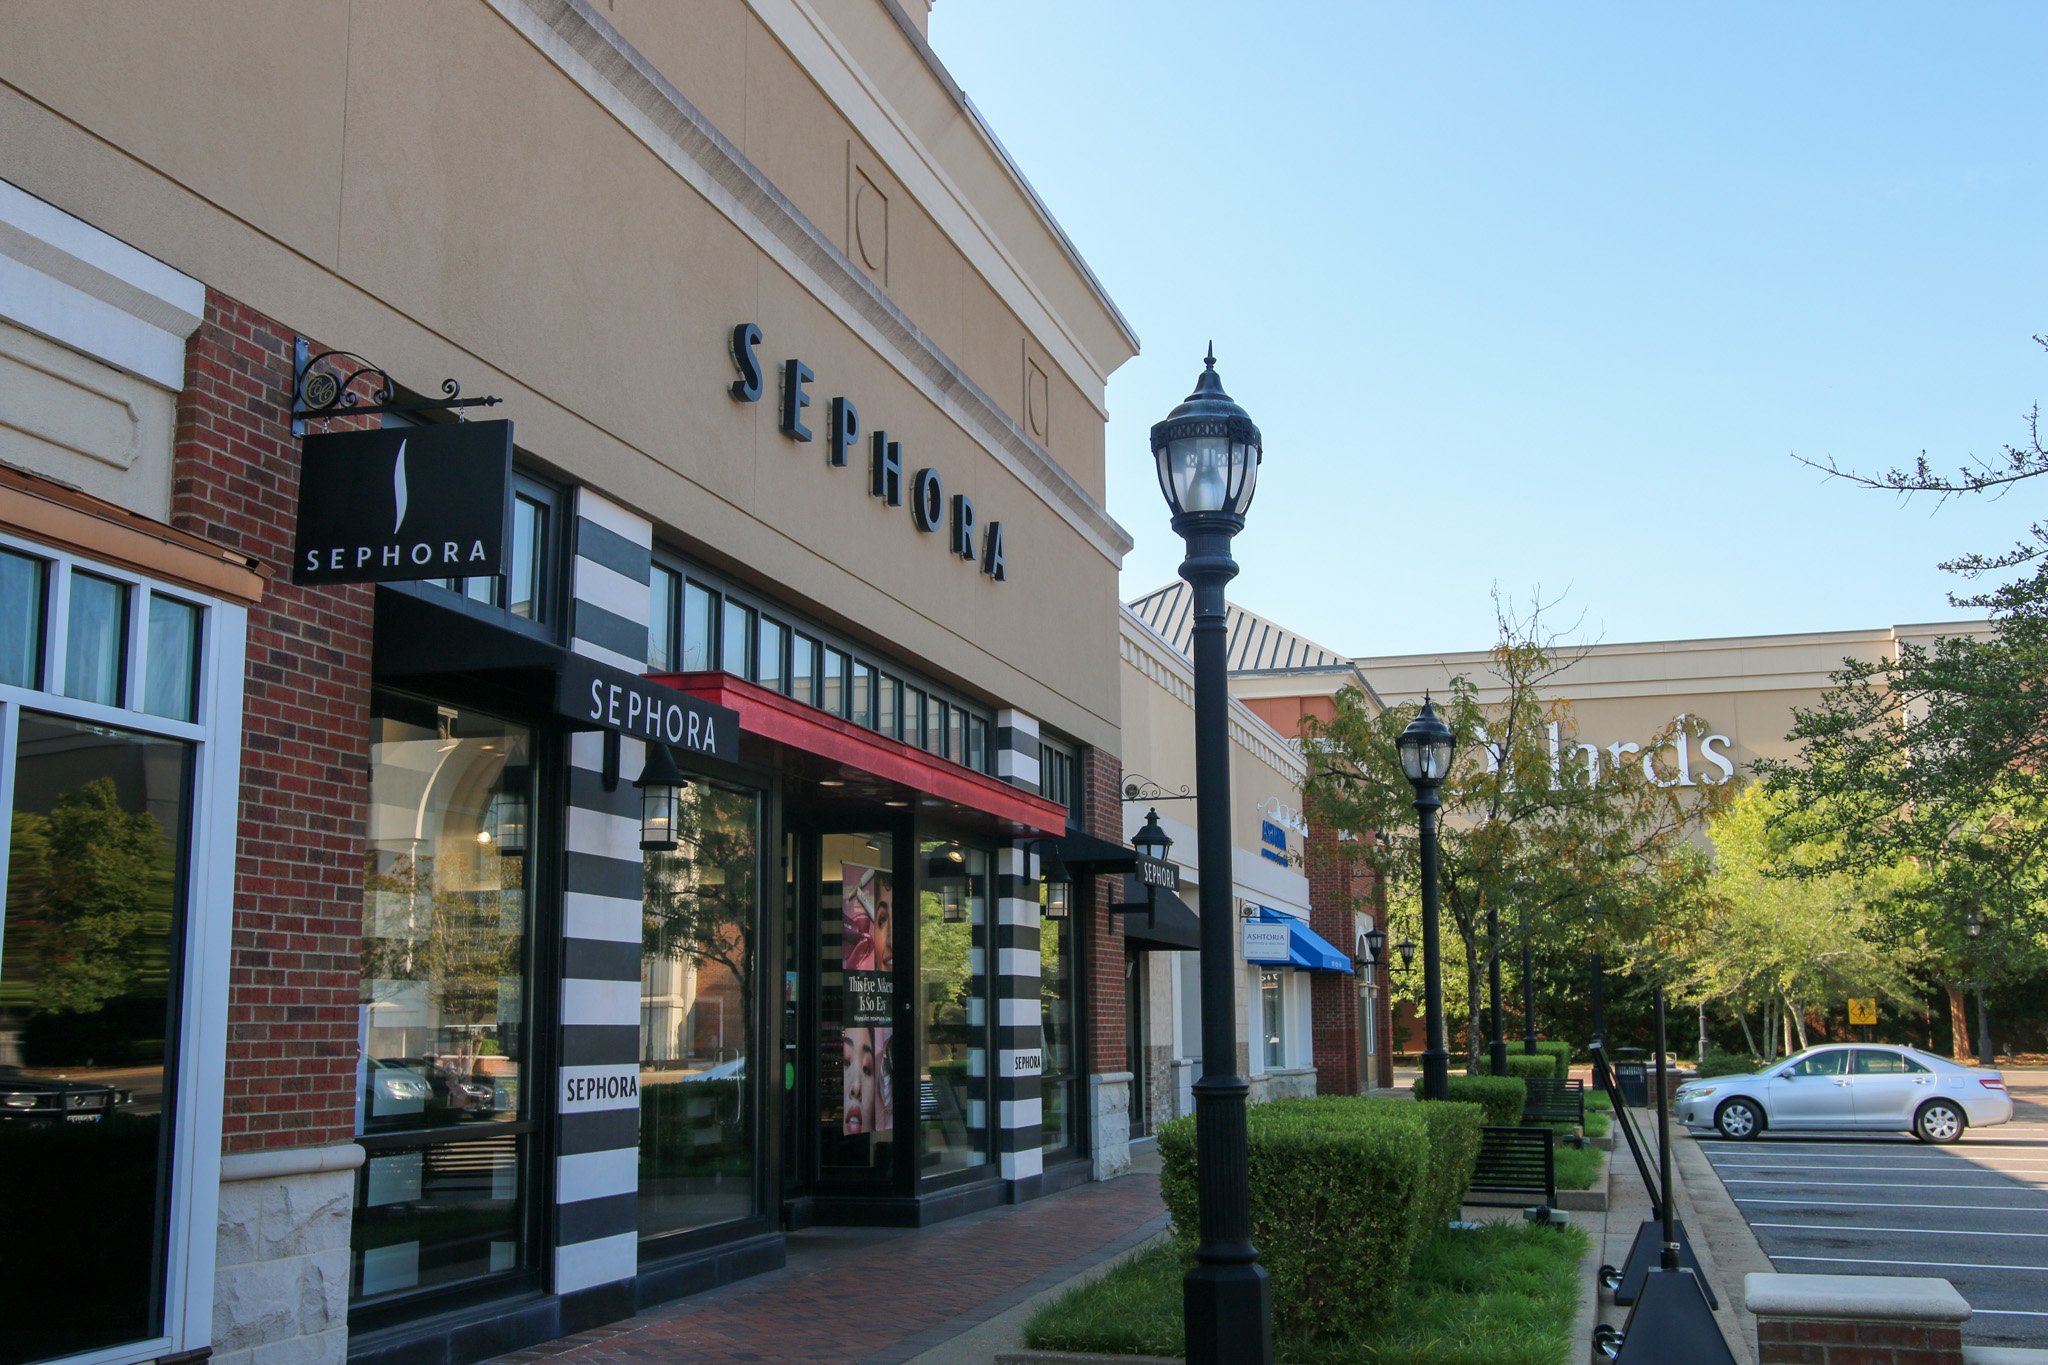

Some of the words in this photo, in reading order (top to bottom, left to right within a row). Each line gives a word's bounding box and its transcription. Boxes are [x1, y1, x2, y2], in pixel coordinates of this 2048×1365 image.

[728, 322, 1007, 581] SEPHORA
[307, 539, 486, 571] SEPHORA
[590, 678, 716, 754] SEPHORA
[1446, 712, 1735, 795] lard's
[1144, 862, 1175, 888] SEPHORA
[1246, 933, 1285, 941] ASHTORIA
[849, 976, 864, 992] This
[864, 977, 876, 995] Eye
[866, 996, 875, 1011] So
[1015, 1055, 1041, 1070] SEPHORA
[567, 1075, 638, 1102] SEPHORA
